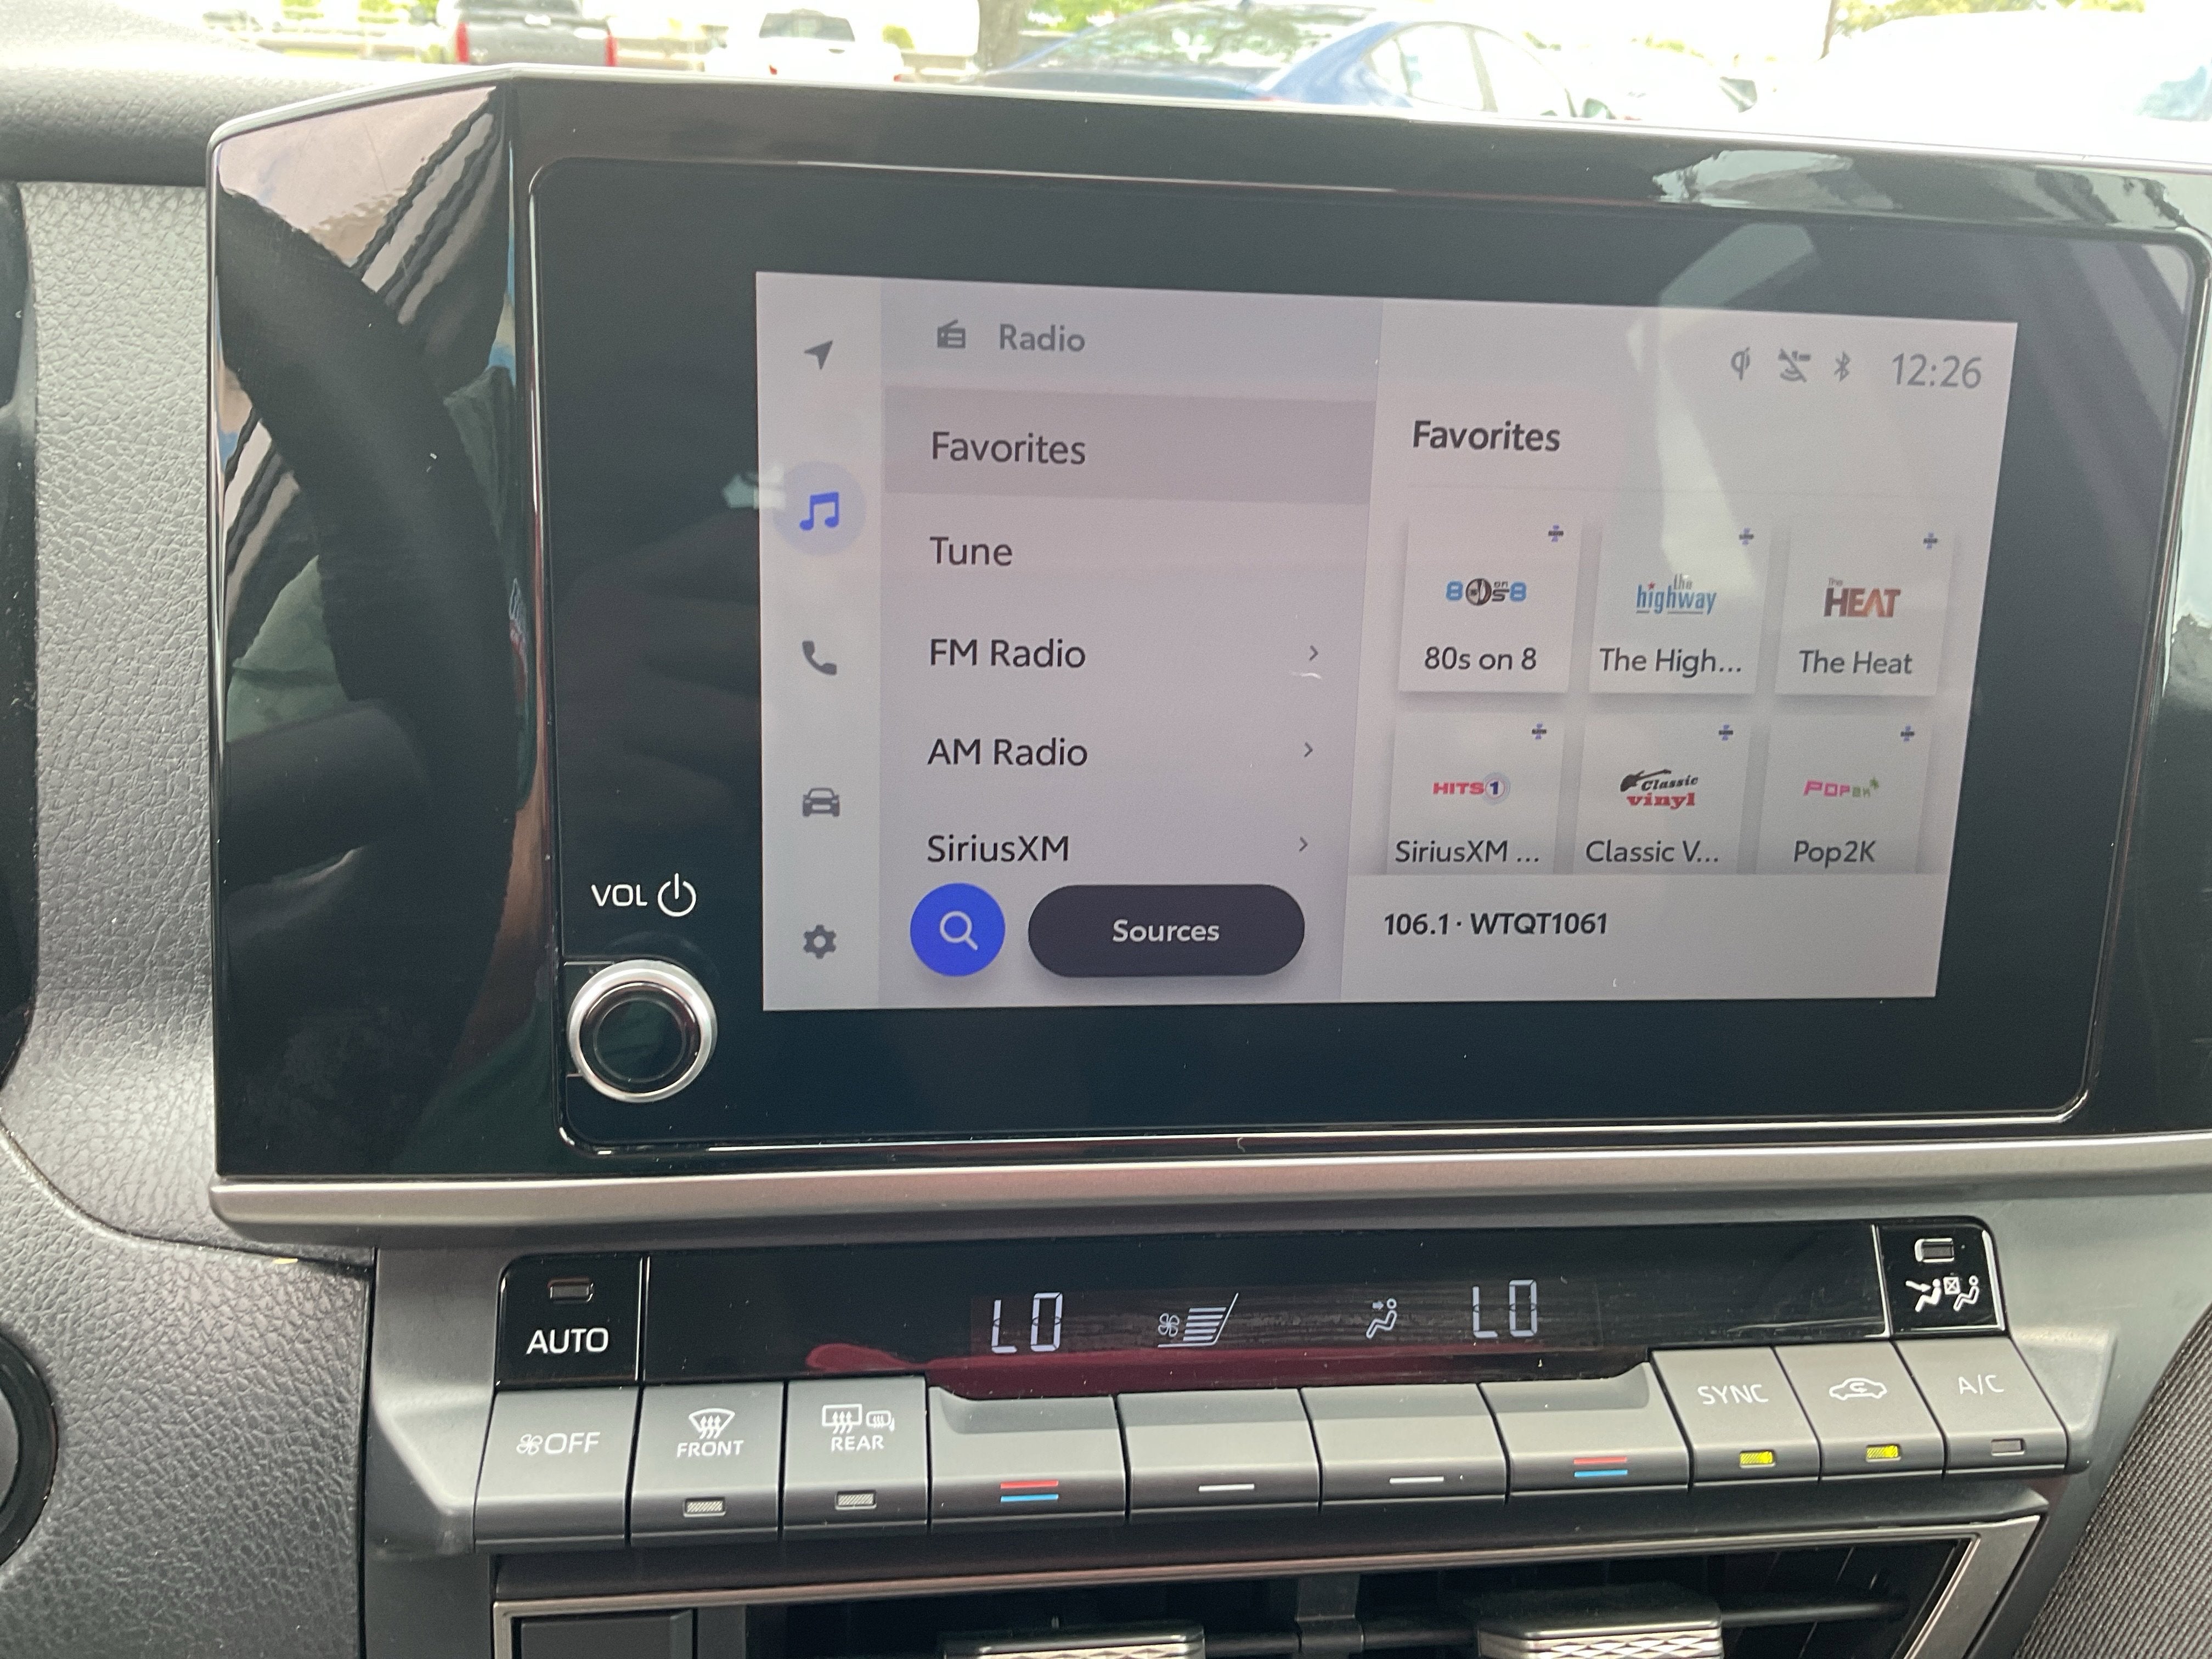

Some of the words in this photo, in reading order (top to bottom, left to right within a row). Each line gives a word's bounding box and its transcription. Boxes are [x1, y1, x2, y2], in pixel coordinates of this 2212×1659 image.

[1000, 324, 1085, 352] Radio
[1893, 353, 1981, 388] 12:26
[1414, 421, 1560, 451] Favorites
[933, 432, 1085, 464] Favorites
[930, 537, 1012, 566] Tune
[1635, 584, 1717, 615] highway
[1824, 588, 1901, 617] HEAT
[931, 639, 977, 665] FM
[991, 639, 1085, 668] Radio
[1425, 647, 1470, 669] 80s
[1479, 654, 1512, 669] on
[1522, 648, 1536, 670] 8
[1600, 647, 1646, 671] The
[1656, 648, 1741, 678] High...
[1799, 650, 1844, 673] The
[1853, 651, 1912, 674] Heat
[928, 739, 980, 764] AM
[995, 737, 1087, 766] Radio
[1432, 782, 1484, 794] HITS
[1489, 781, 1499, 795] 1
[1641, 774, 1699, 791] Classic
[1627, 792, 1695, 809] vinyl
[928, 834, 1068, 862] SiriusXM
[1396, 840, 1507, 862] SiriusXM
[1587, 840, 1674, 862] Classic
[1795, 841, 1875, 868] Pop2K
[591, 884, 647, 906] VOL
[1113, 920, 1219, 941] Sources
[1471, 913, 1606, 934] WTQT1061
[527, 1328, 608, 1354] AUTO
[1698, 1385, 1768, 1404] SYNC
[1959, 1375, 2004, 1395] A/C
[545, 1432, 600, 1454] OFF
[677, 1436, 743, 1457] FRONT
[831, 1435, 884, 1451] REAR
